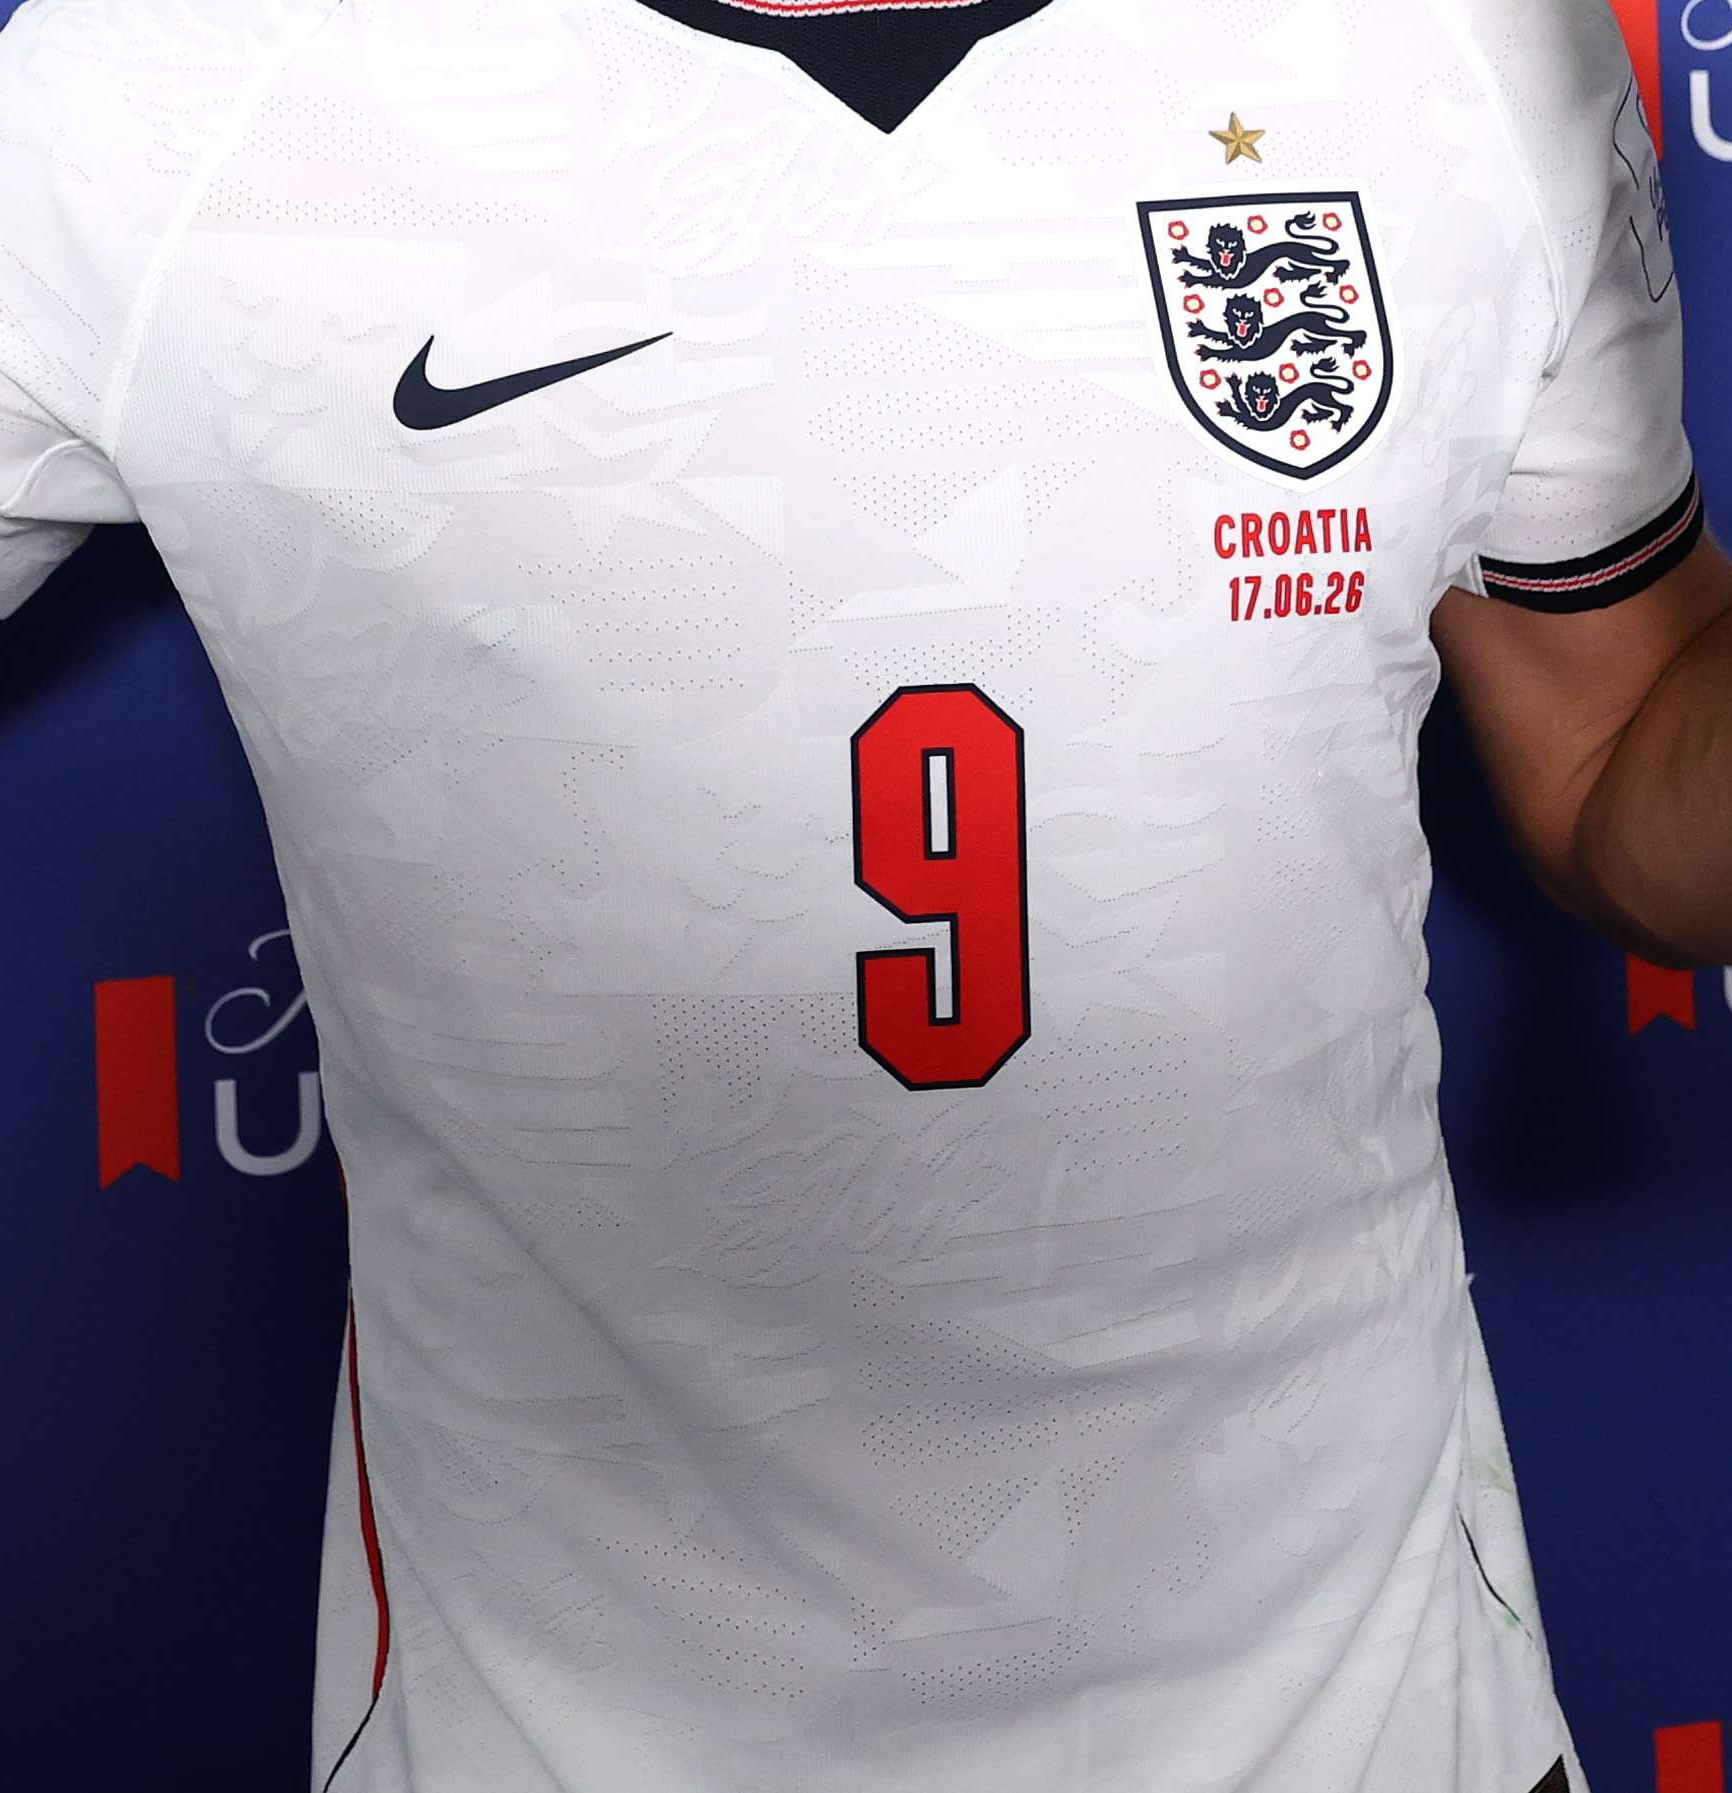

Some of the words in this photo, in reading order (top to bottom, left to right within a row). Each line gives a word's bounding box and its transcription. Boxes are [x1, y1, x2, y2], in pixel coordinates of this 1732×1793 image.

[1214, 507, 1372, 559] CROATIA
[1229, 570, 1365, 621] 17.06.26
[850, 683, 1031, 1091] 9
